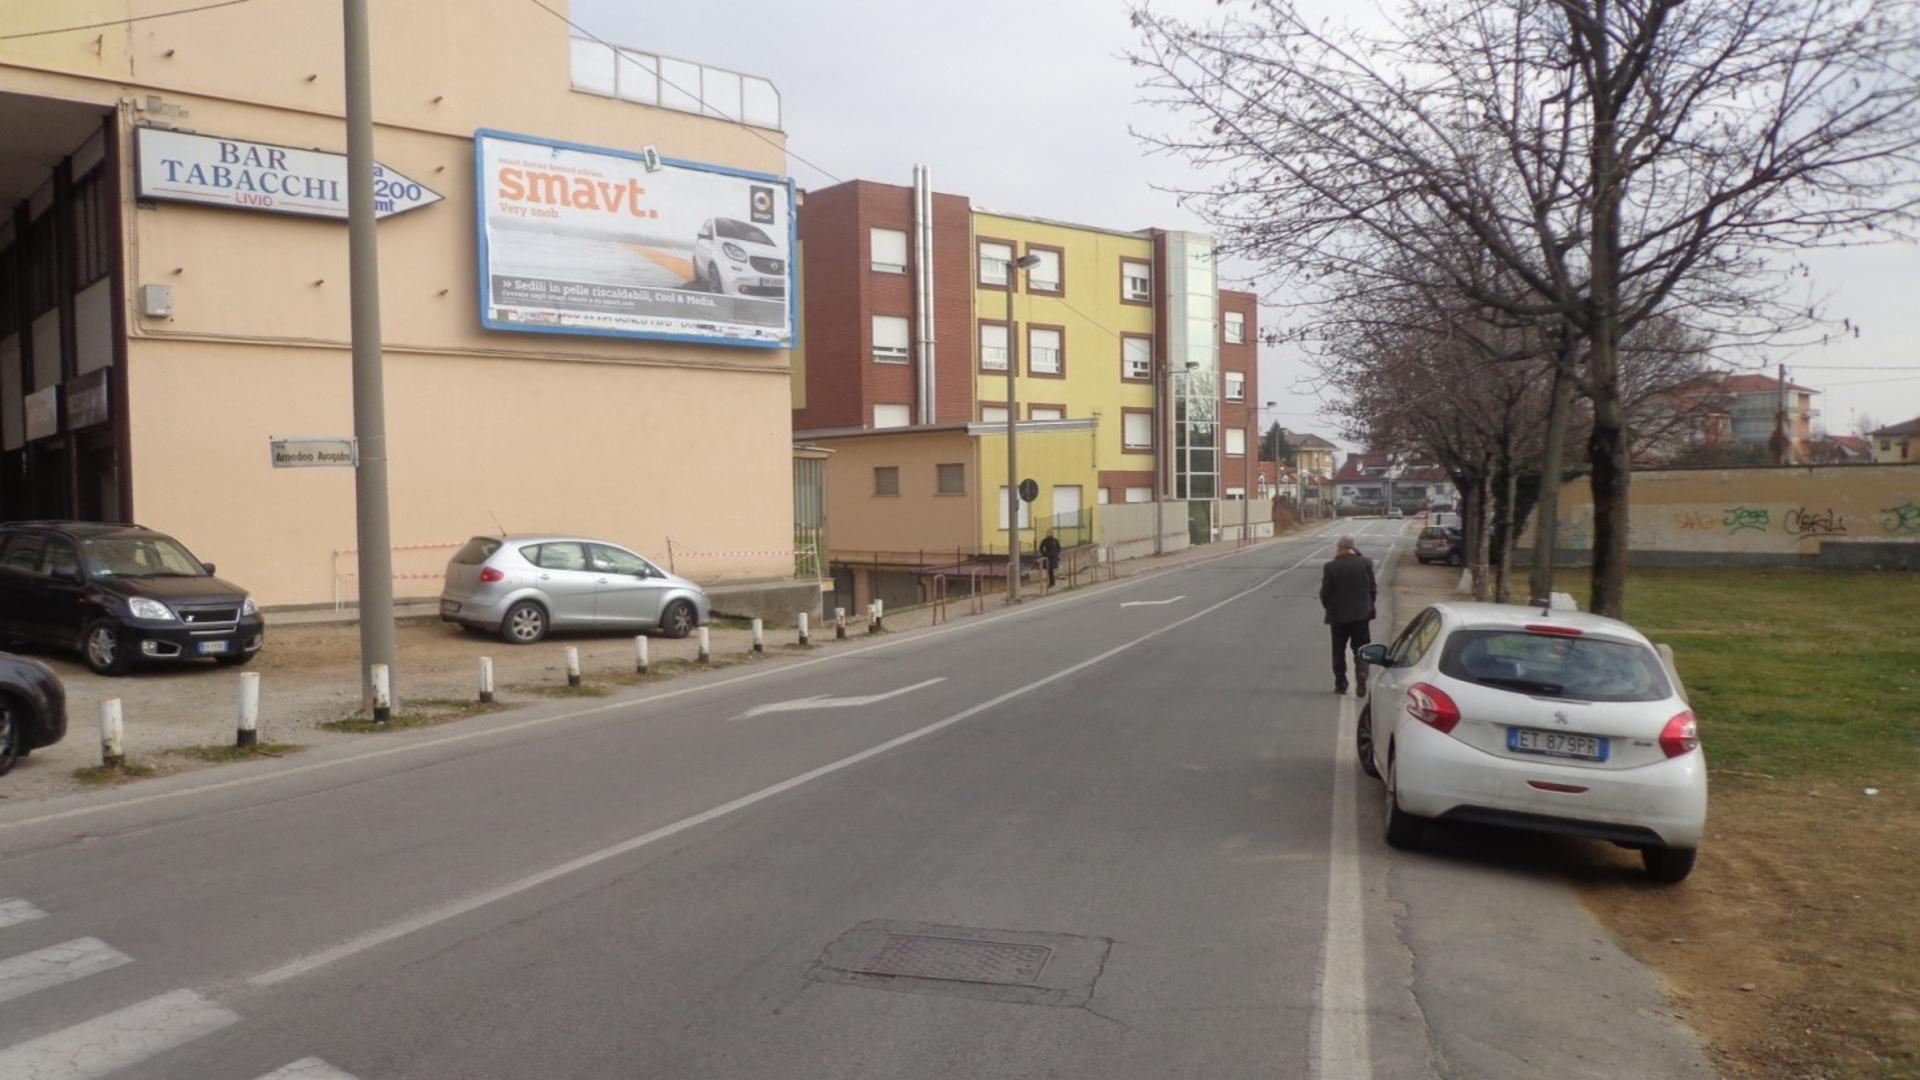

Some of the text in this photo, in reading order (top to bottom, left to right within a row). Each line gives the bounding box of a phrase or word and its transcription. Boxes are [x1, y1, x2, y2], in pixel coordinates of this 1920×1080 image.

[218, 142, 288, 171] BAR
[161, 159, 339, 202] TABACCHI
[374, 180, 422, 202] 200
[235, 191, 273, 207] LIVIO
[498, 167, 659, 219] smavt.
[500, 202, 562, 219] Very snob.
[514, 279, 547, 292] Sedili
[549, 281, 561, 293] in
[563, 284, 590, 297] pelle
[655, 291, 676, 302] Cool
[1519, 730, 1597, 755] ET 879PR
